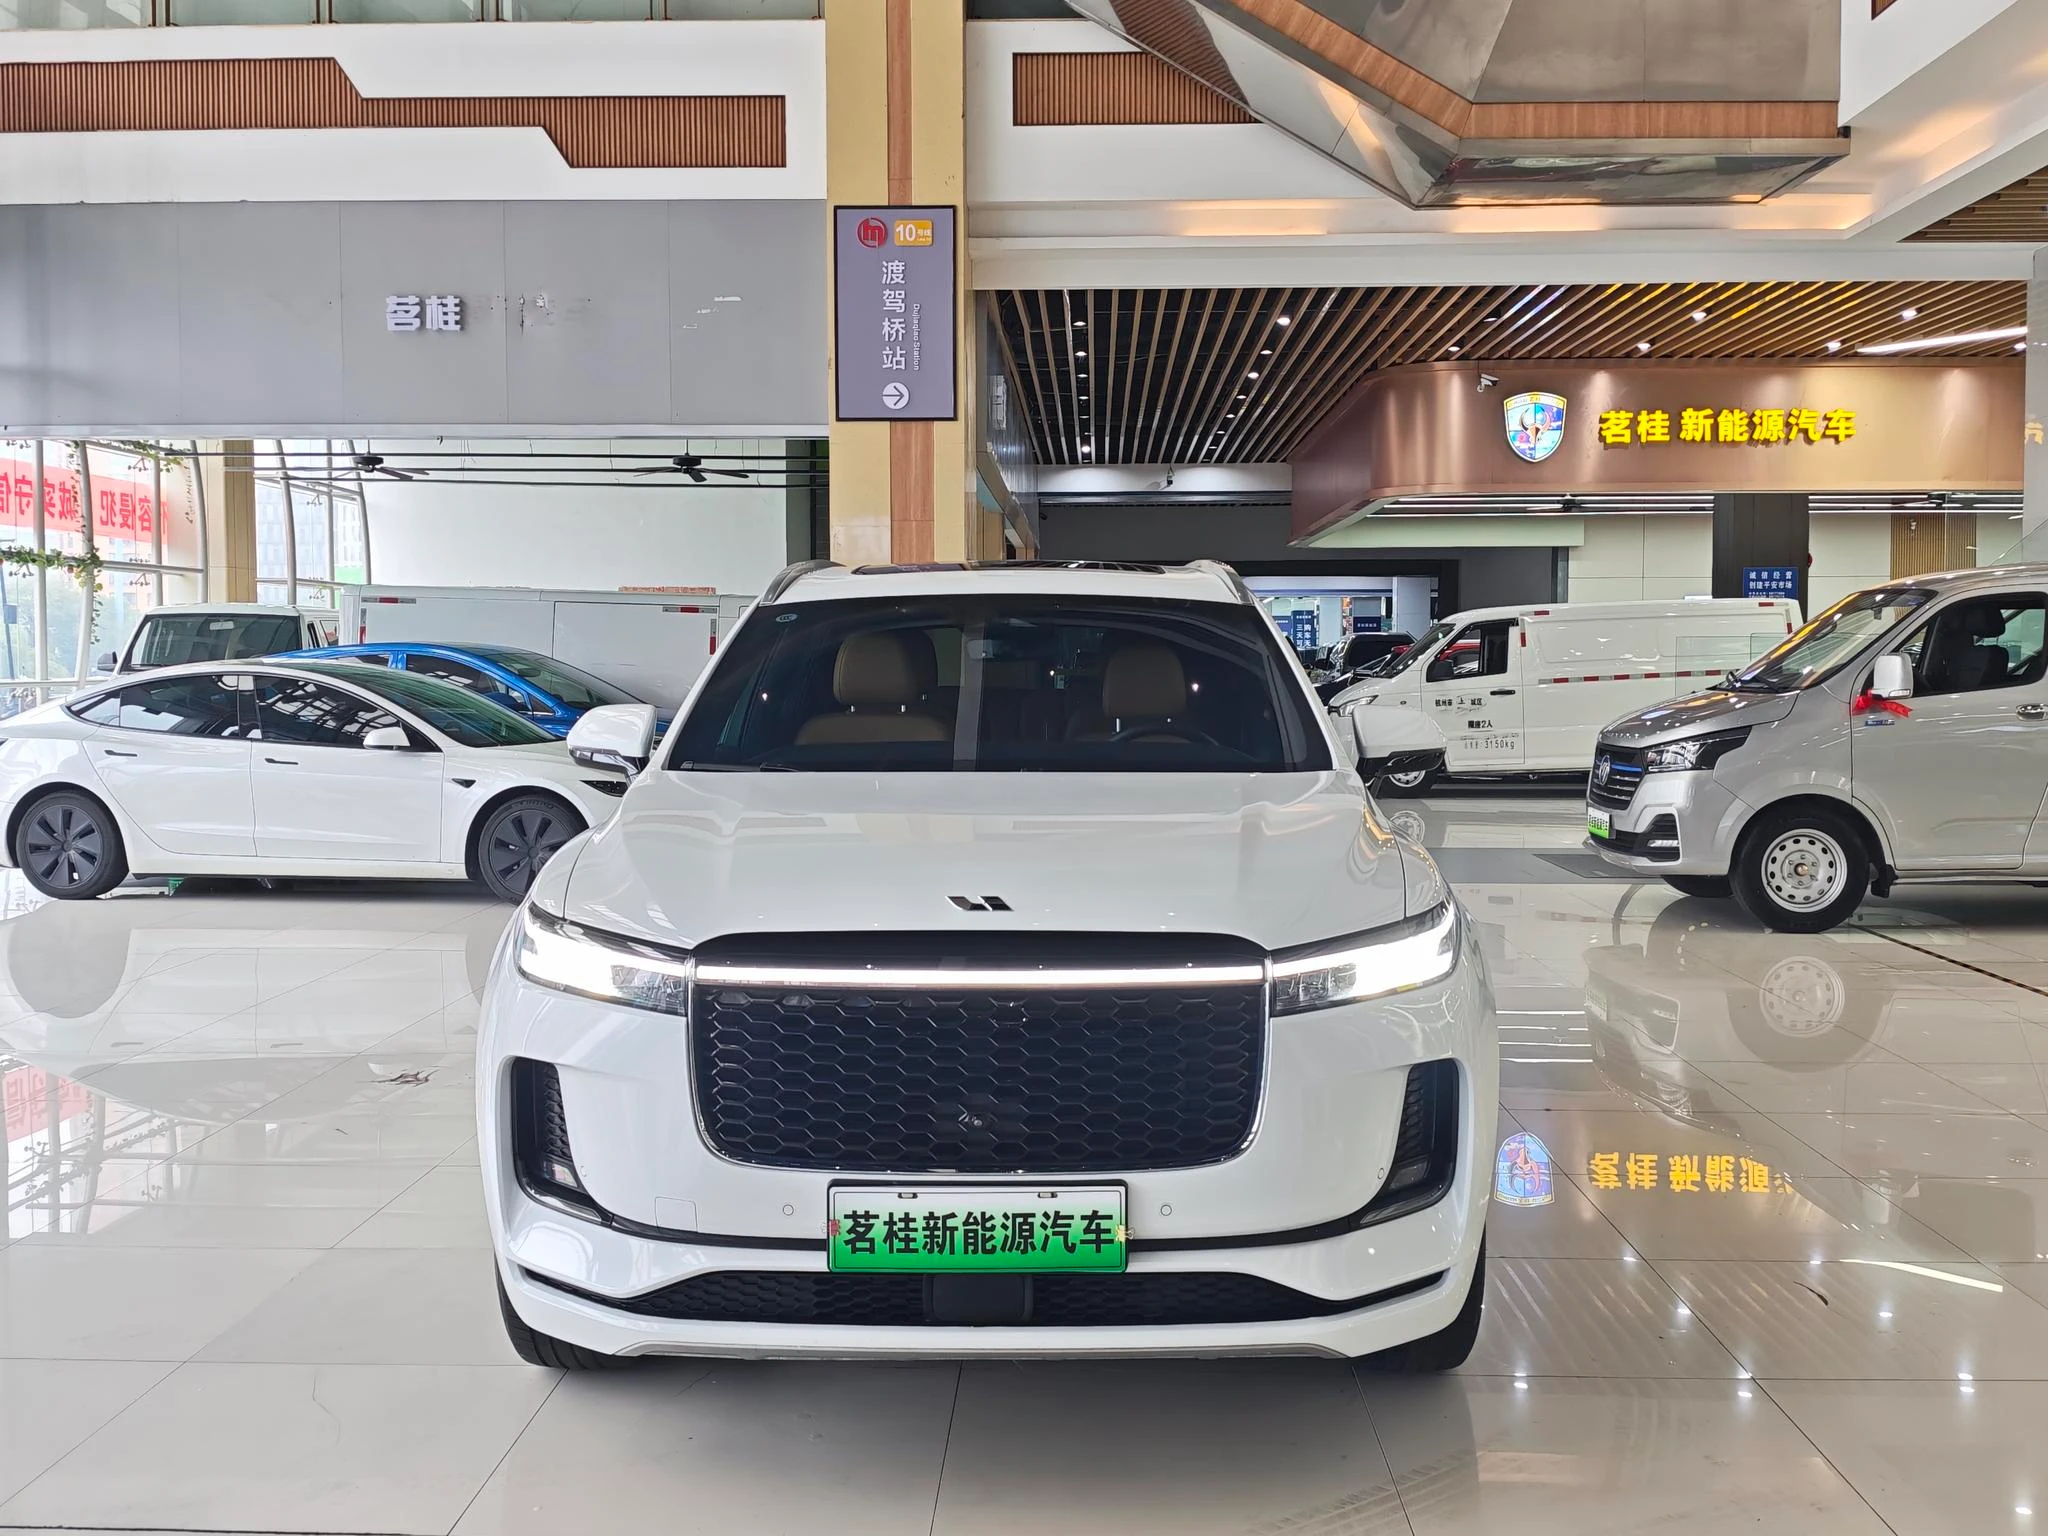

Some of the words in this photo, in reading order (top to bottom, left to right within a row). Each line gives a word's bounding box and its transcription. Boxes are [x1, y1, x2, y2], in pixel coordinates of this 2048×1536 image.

[386, 295, 461, 332] 茗桂
[882, 260, 906, 371] 渡驾桥站
[913, 341, 921, 371] Station
[843, 1210, 1115, 1256] 茗桂新能源汽车
